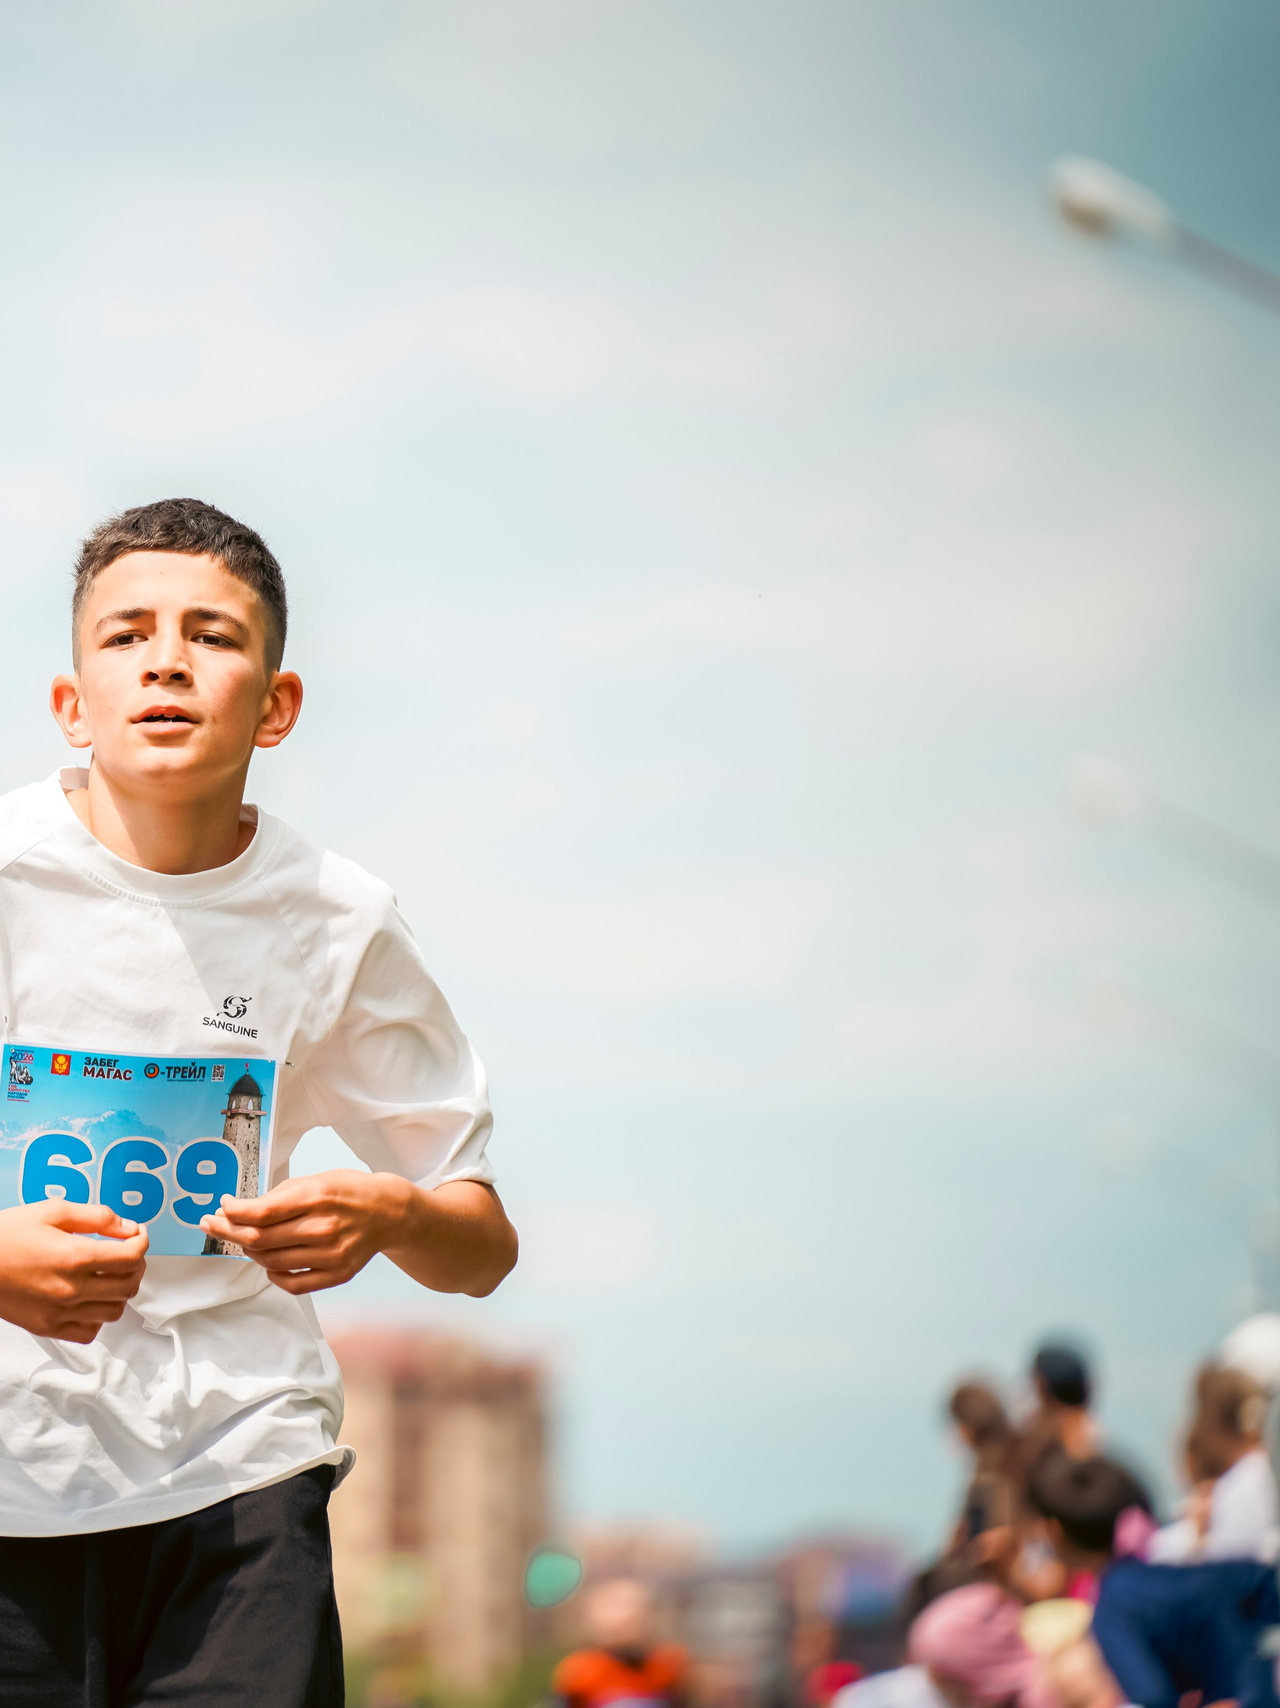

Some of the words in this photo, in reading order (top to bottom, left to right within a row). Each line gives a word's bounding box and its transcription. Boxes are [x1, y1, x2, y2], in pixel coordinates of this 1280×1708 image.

[202, 1016, 258, 1039] SANGUINE
[11, 1051, 34, 1062] 2026
[84, 1057, 119, 1068] ЗАБЕГ
[82, 1066, 133, 1081] МАГАС
[19, 1130, 242, 1228] 669
